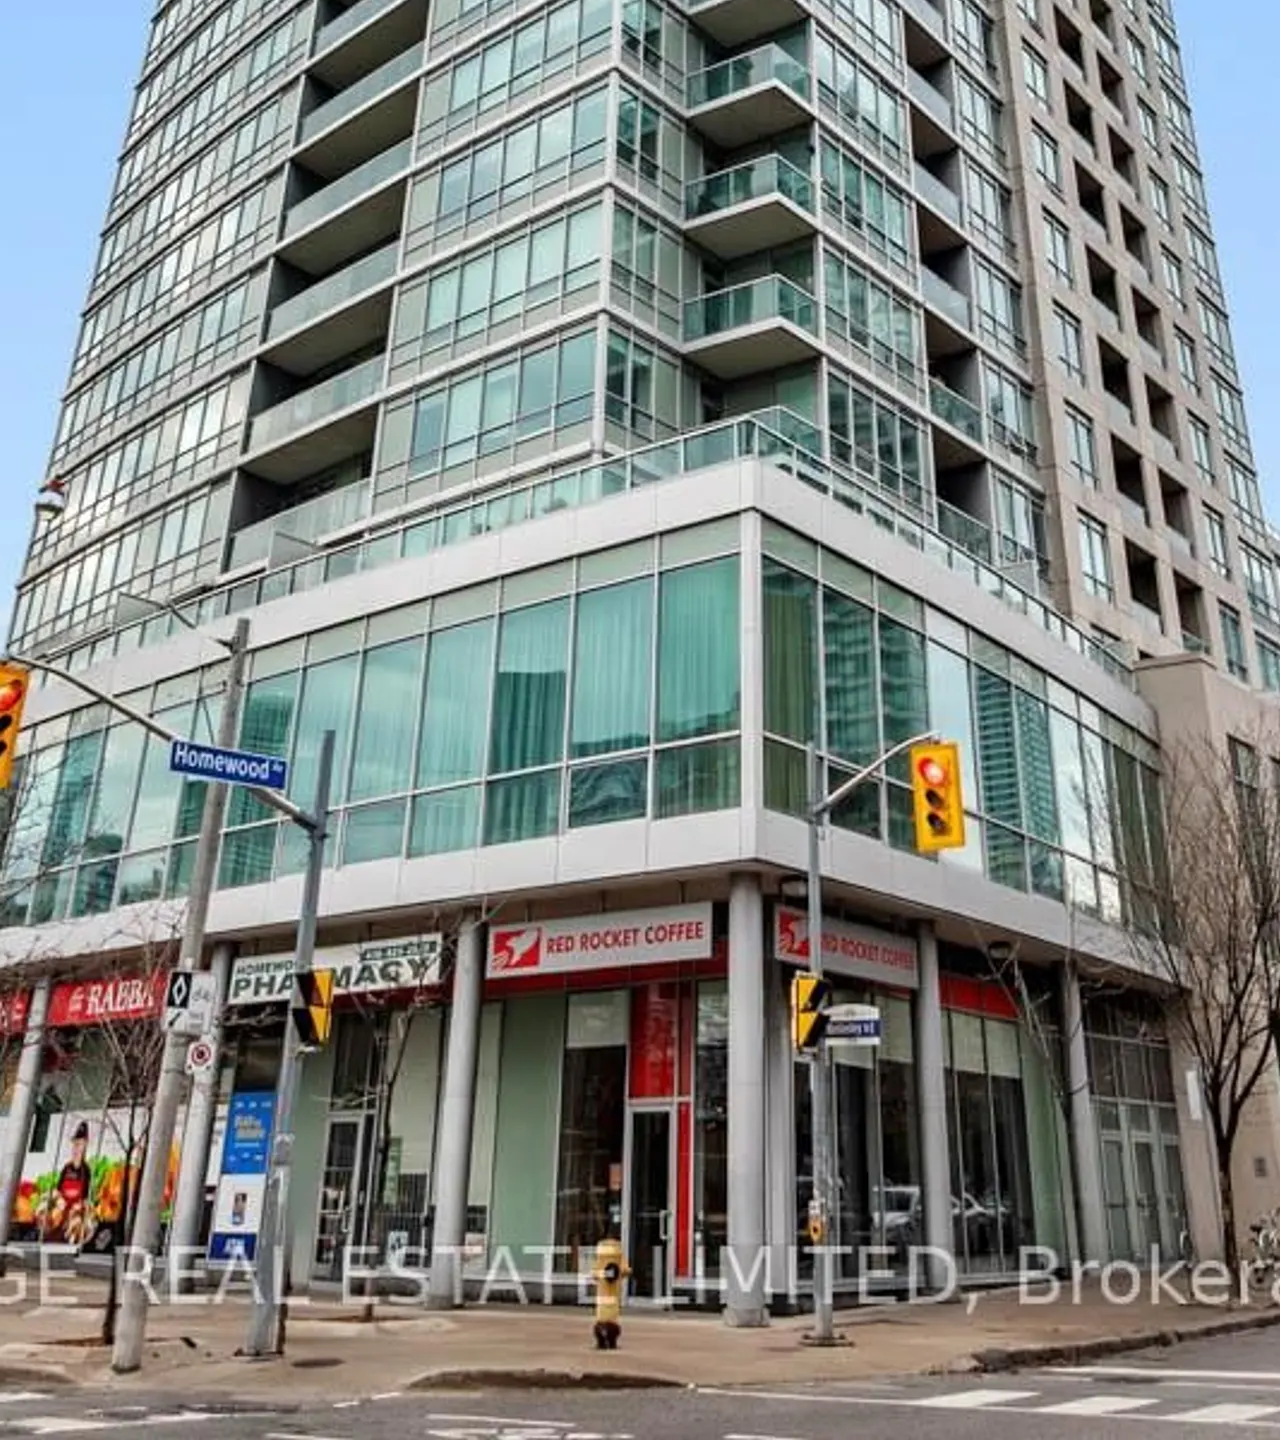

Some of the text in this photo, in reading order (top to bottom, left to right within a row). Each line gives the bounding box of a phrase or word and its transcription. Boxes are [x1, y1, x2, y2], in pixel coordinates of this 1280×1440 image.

[175, 741, 269, 779] Homewood
[547, 921, 704, 954] RED ROCKET COFFEE
